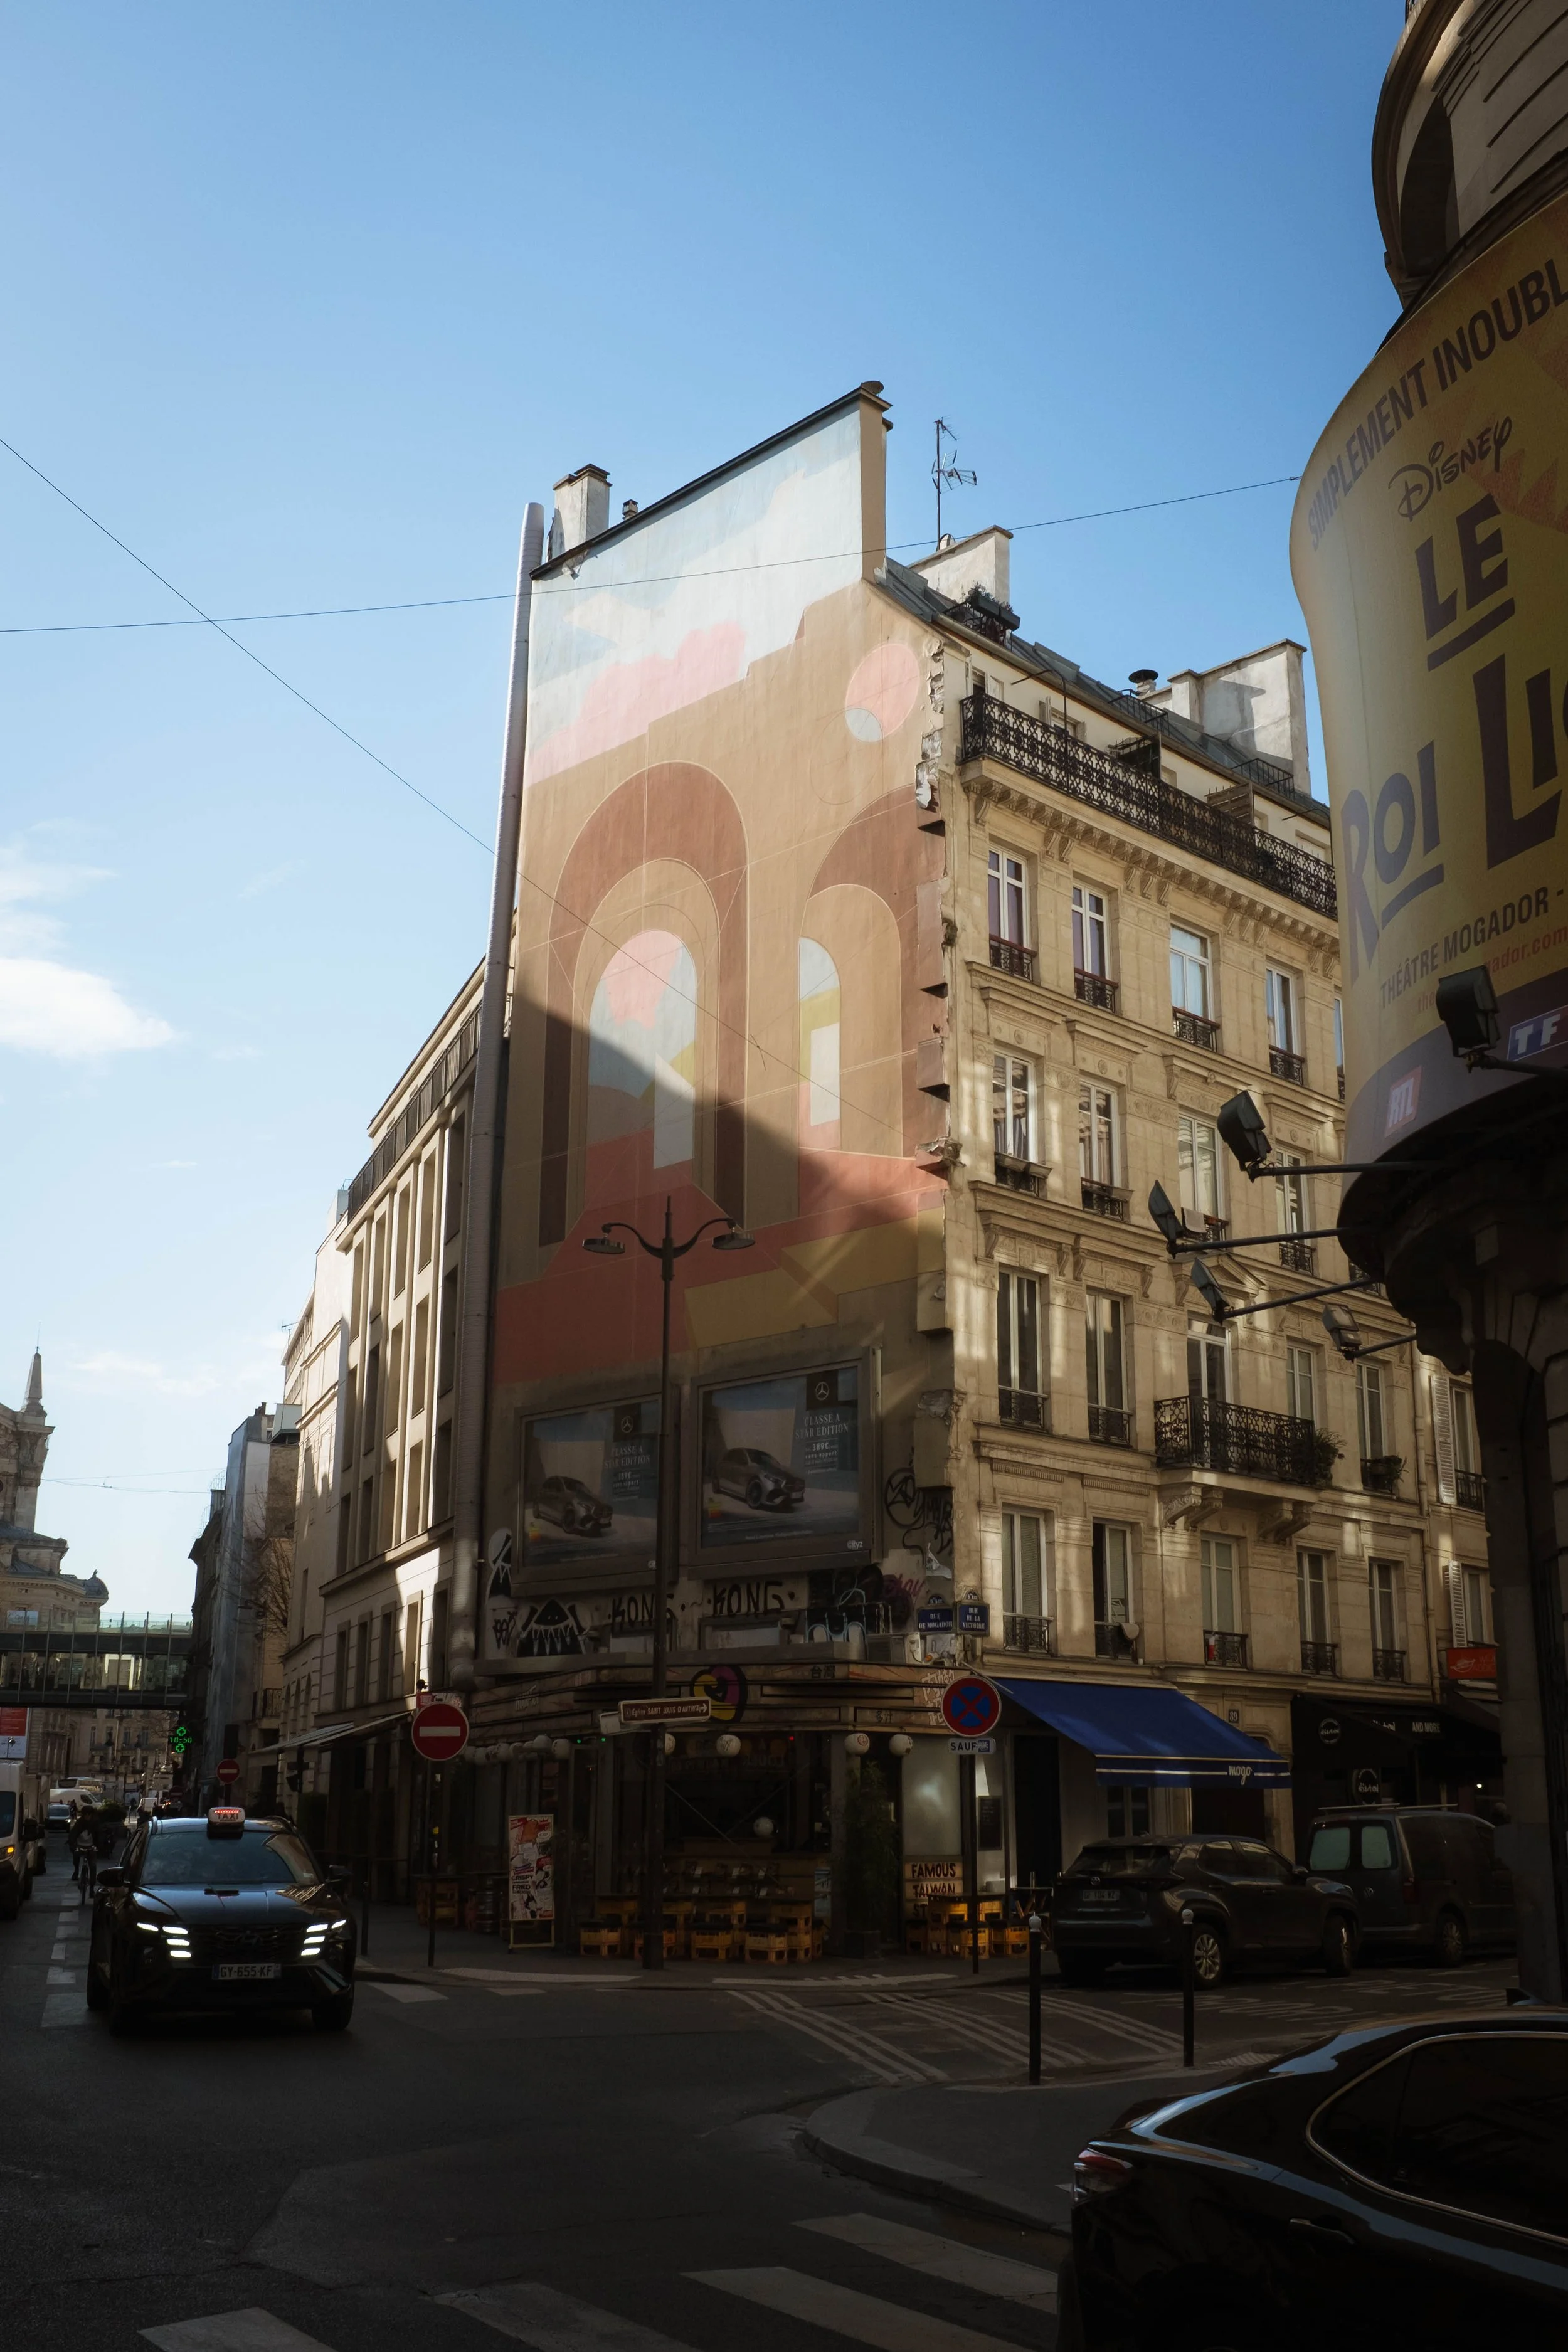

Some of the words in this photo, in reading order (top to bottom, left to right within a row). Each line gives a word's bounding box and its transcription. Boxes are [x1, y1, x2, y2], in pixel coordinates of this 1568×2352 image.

[1308, 359, 1428, 552] SIMPLEMENT
[1415, 493, 1509, 641] LE
[1472, 653, 1568, 869] LI
[1341, 741, 1442, 986] ROI
[1380, 942, 1439, 1009] THÉÂTRE
[1443, 886, 1549, 964] MOGADOR
[1389, 1077, 1414, 1128] RTL
[804, 1413, 834, 1427] CLASSE
[835, 1412, 840, 1422] A
[796, 1428, 815, 1439] STAR
[817, 1422, 849, 1436] EDITION
[621, 1455, 650, 1466] EDITION
[713, 1580, 785, 1619] KONG
[962, 1621, 985, 1629] VICTOIRE
[647, 1707, 661, 1715] SAINT
[663, 1706, 676, 1714] LOUIS
[1229, 1711, 1238, 1722] 89
[1412, 1721, 1424, 1732] AND
[1424, 1722, 1441, 1733] MORE
[950, 1742, 977, 1751] SAUF
[1229, 1766, 1253, 1785] mogo
[911, 1863, 956, 1878] FAMOUS
[913, 1883, 955, 1898] TAIWAN
[220, 1966, 273, 1978] GY-655-KF
